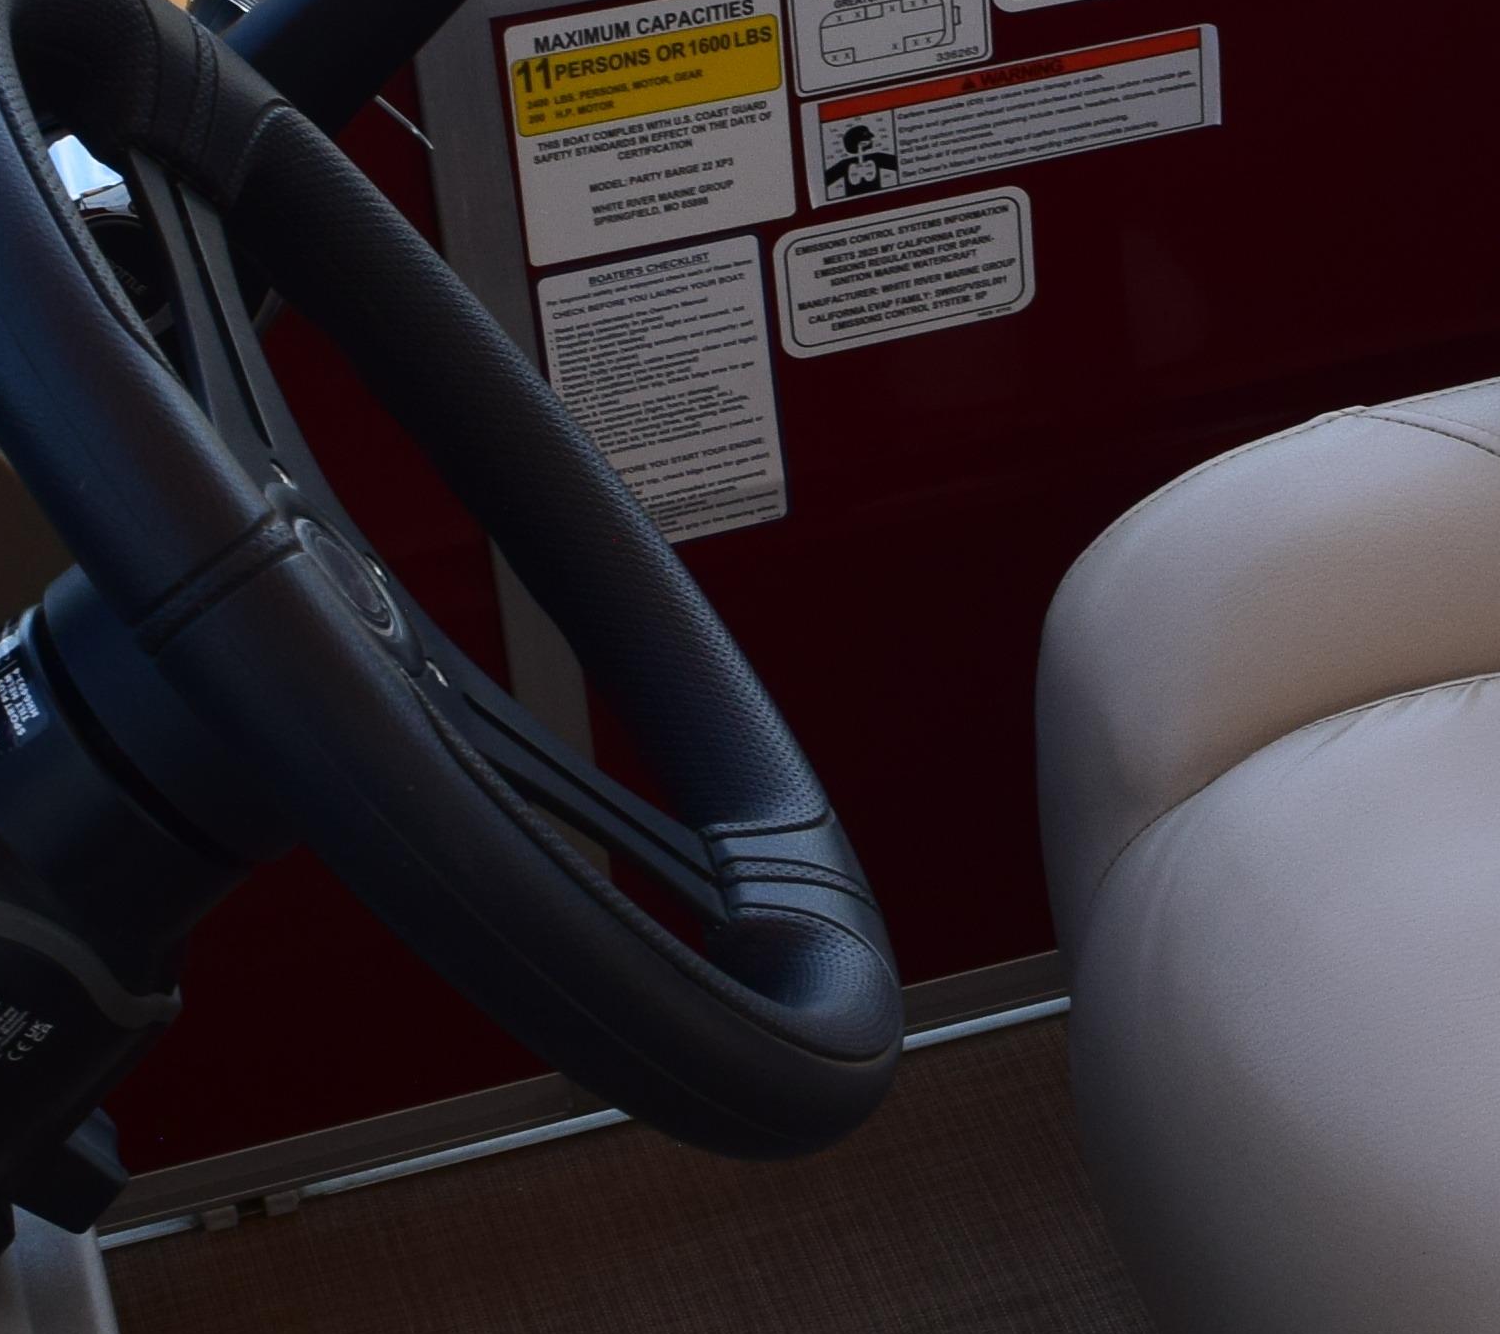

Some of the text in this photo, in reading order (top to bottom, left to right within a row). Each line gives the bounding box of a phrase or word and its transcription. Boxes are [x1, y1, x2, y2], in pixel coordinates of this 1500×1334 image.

[534, 0, 754, 53] MAXIMUM CAPACITIES
[515, 26, 772, 94] 11 PERSONS OR 1600 LBS
[675, 69, 702, 82] GEAR
[980, 59, 1064, 87] WARNING
[578, 101, 614, 114] MOTOR
[897, 110, 924, 119] Carbon
[927, 102, 964, 113] monoxide
[898, 123, 923, 134] Engine
[941, 113, 973, 125] generator
[976, 107, 1004, 117] exhaust
[1069, 91, 1082, 99] and
[533, 112, 772, 164] SAFETY STANDARDS IN EFFECT ON THE DATE OF
[538, 101, 767, 151] THIS BOAT COMPLIES WITH U.S. COAST GUARD
[617, 139, 692, 160] CERTIFICATION
[629, 171, 662, 184] PARTY
[665, 165, 698, 178] BARGE
[593, 180, 734, 214] WHITE RIVER MARINE GROUP
[664, 203, 679, 213] MO
[796, 204, 1008, 256] EMISSIONS CONTROL SYSTEMS INFORMATION
[823, 252, 855, 266] MEETS
[897, 231, 953, 250] CALIFORNIA
[956, 225, 981, 237] EVAP
[589, 266, 643, 285] BOATER'S
[646, 252, 709, 272] CHECKLIST
[815, 261, 866, 279] EMISSIONS
[868, 246, 935, 267] REGULATIONS
[938, 241, 957, 252] FOR
[831, 249, 976, 287] IGNITION MARINE WATERCRAFT
[882, 280, 911, 293] WHITE
[914, 273, 941, 286] RIVER
[944, 265, 980, 279] MARINE
[983, 257, 1016, 271] GROUP
[553, 307, 585, 319] CHECK
[588, 299, 624, 312] BEFORE
[628, 294, 647, 303] YOU
[650, 285, 686, 298] LAUNCH
[690, 279, 716, 290] YOUR
[808, 305, 865, 324] CALIFORNIA
[868, 299, 892, 311] EVAP
[832, 313, 882, 331] EMISSIONS
[885, 303, 929, 319] CONTROL
[650, 459, 668, 468] YOU
[671, 452, 698, 463] START
[703, 446, 726, 456] YOUR
